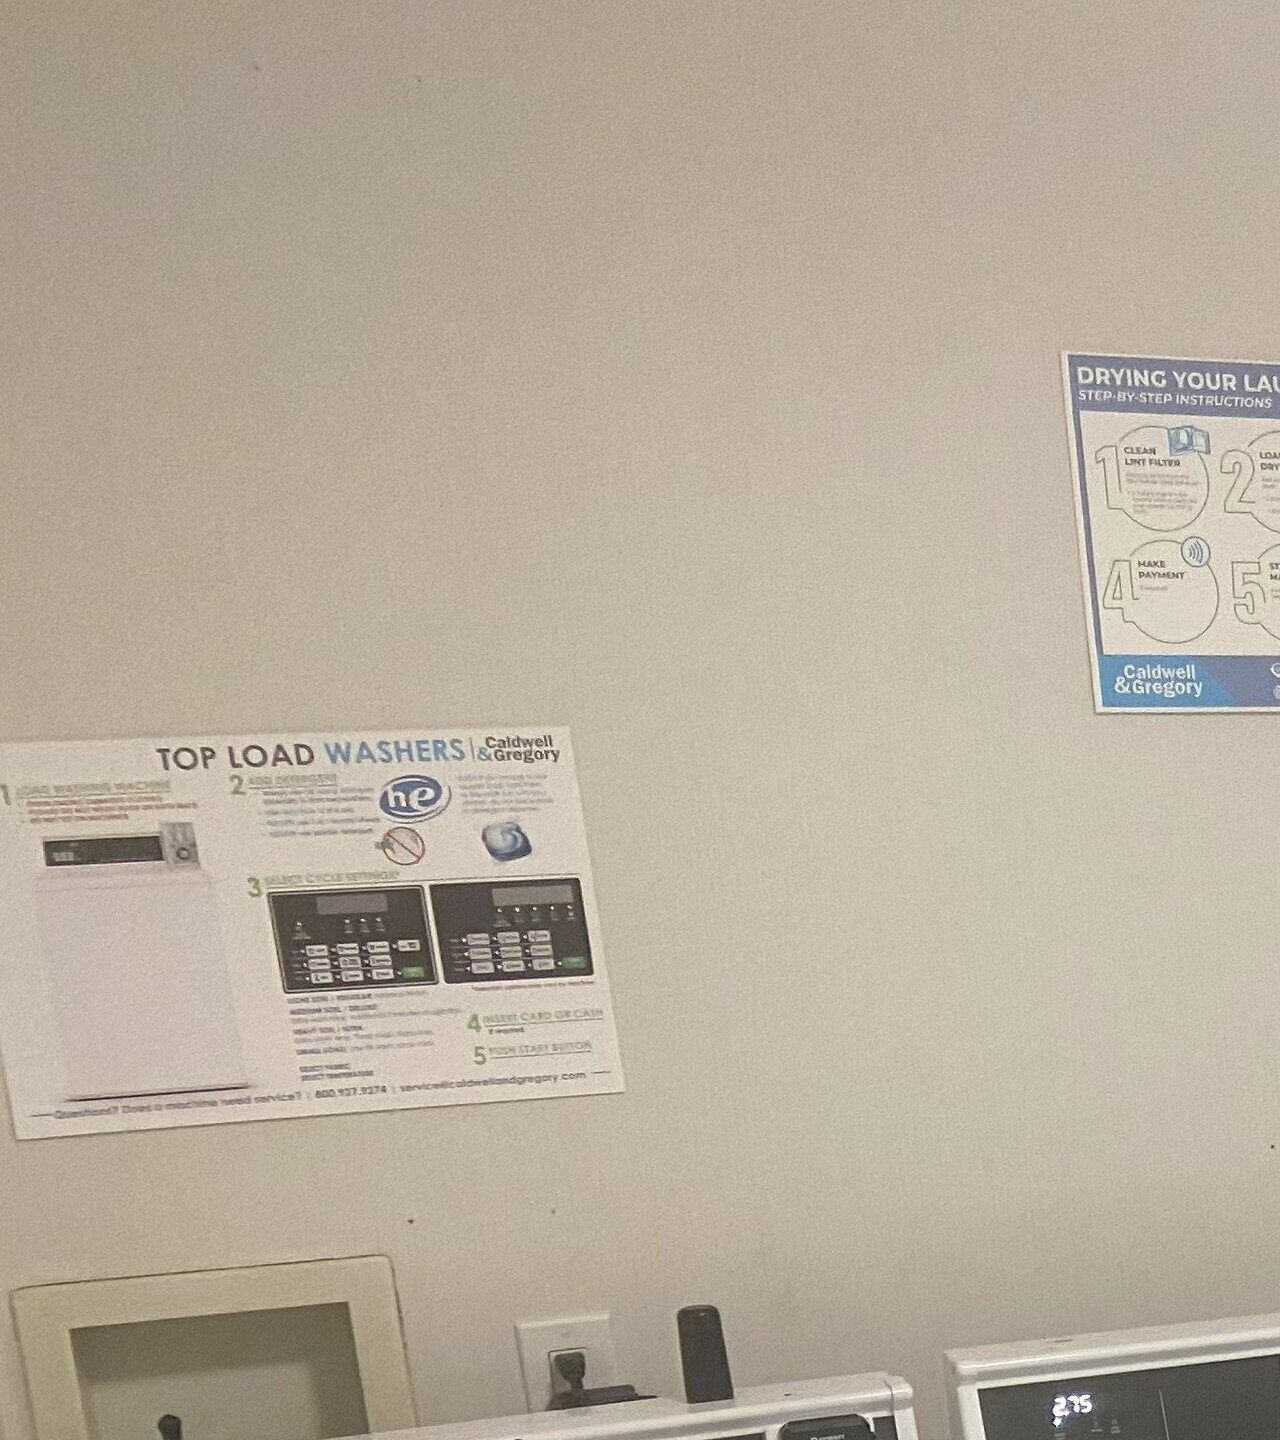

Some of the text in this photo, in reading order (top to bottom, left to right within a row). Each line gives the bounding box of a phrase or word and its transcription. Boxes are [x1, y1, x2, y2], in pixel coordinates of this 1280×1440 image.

[1076, 366, 1167, 386] DRYING
[1172, 371, 1237, 391] YOUR
[1078, 389, 1273, 409] STEP-BY-STEP INSTRUCTIONS
[1124, 446, 1157, 456] CLEAN
[1125, 457, 1182, 468] LINT FILTER
[1137, 559, 1166, 569] MAKE
[1138, 570, 1187, 580] PAYMENT
[1123, 663, 1196, 681] Caldwell
[1114, 675, 1203, 698] &Gregory
[485, 734, 554, 750] Caldwell
[155, 738, 466, 771] TOP LOAD WASHERS
[476, 747, 561, 764] &Gregory
[229, 774, 247, 796] 2
[247, 876, 263, 898] 3
[467, 1013, 482, 1033] 4
[473, 1045, 487, 1066] 5
